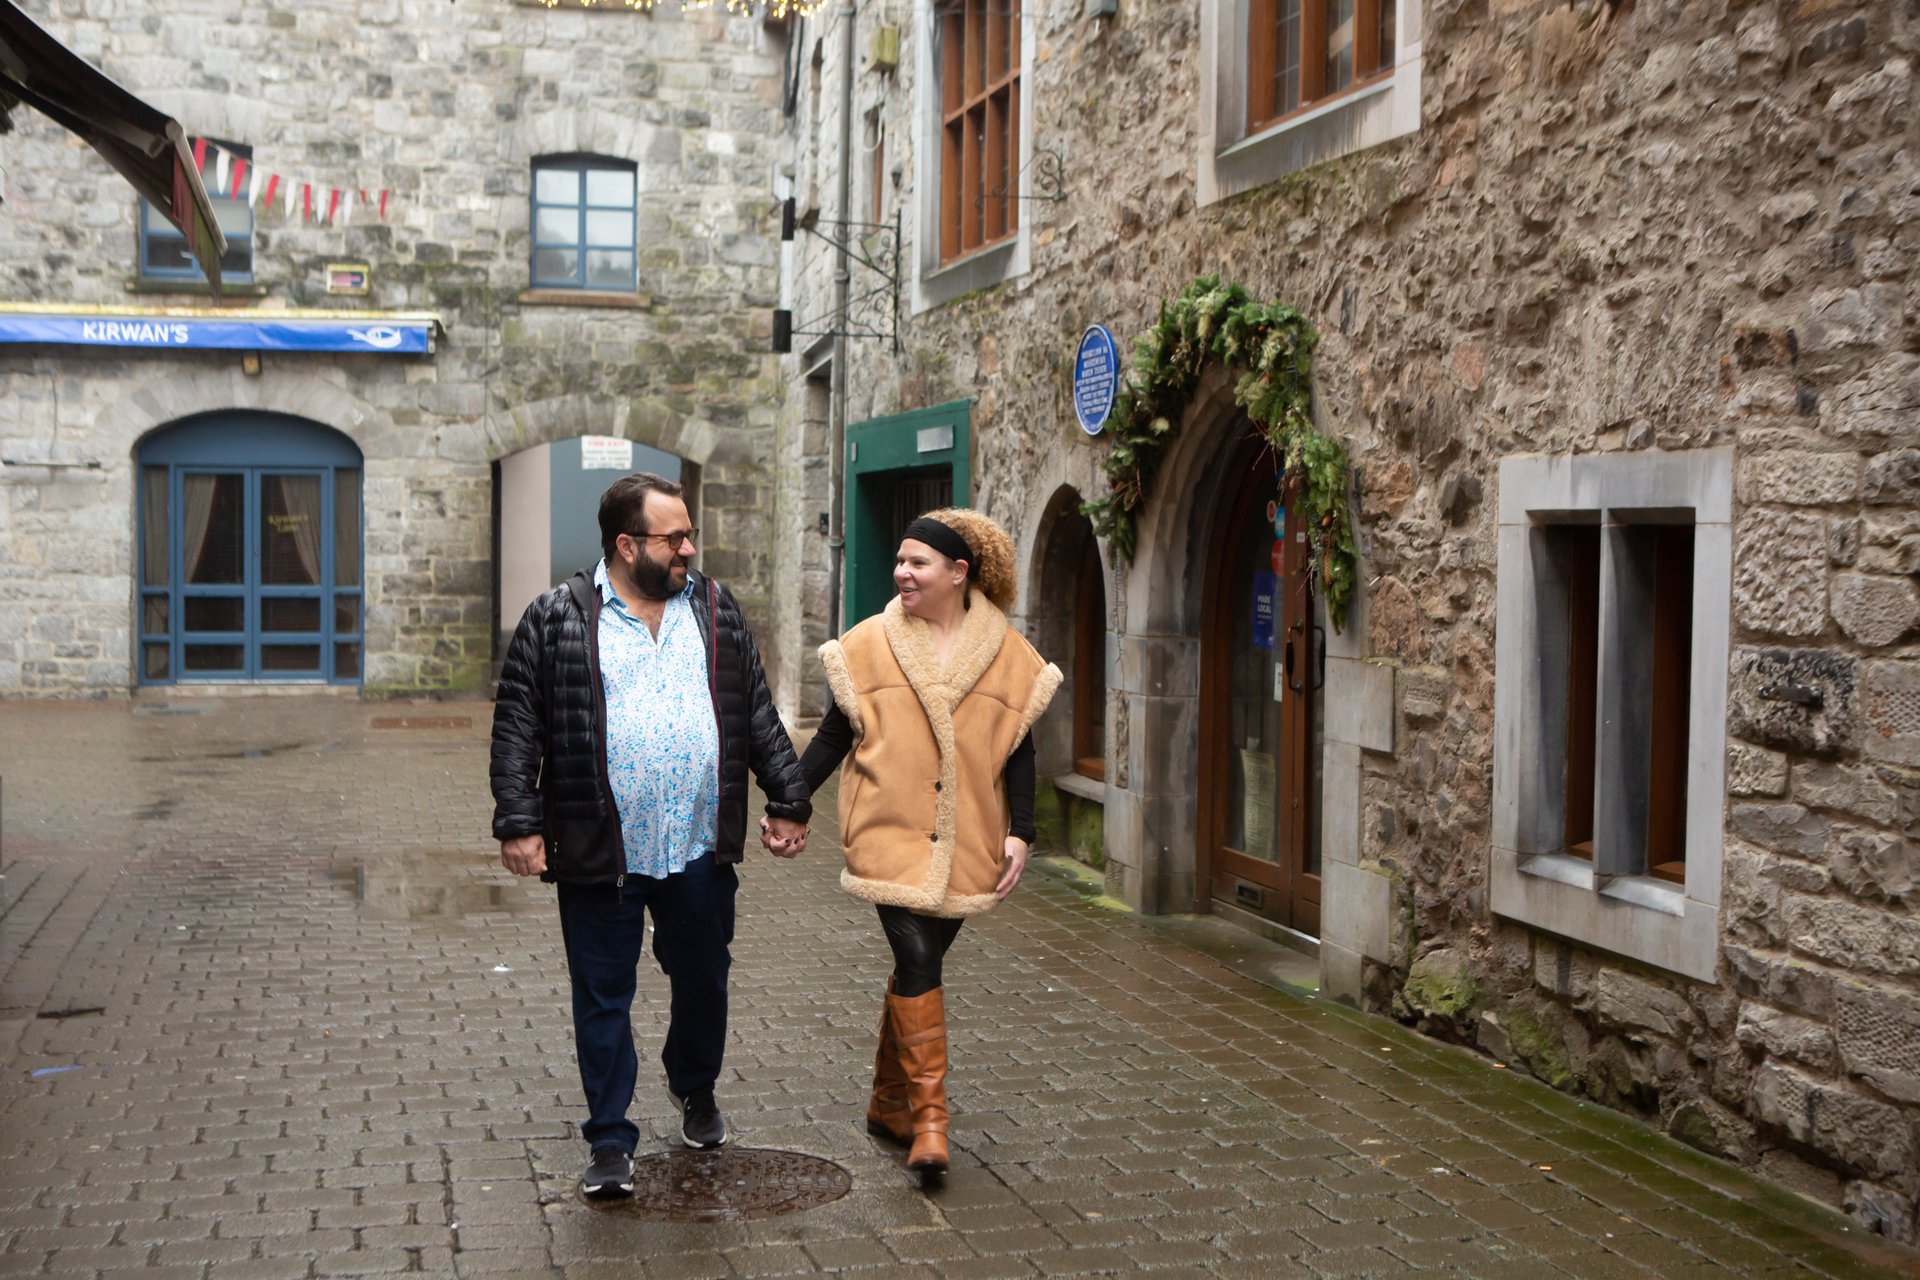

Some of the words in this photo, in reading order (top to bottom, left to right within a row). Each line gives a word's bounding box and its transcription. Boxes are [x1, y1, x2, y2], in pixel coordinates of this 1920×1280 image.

[83, 321, 188, 343] KIRWAN'S
[1257, 595, 1271, 604] MADE
[1257, 604, 1272, 614] LOCAL
